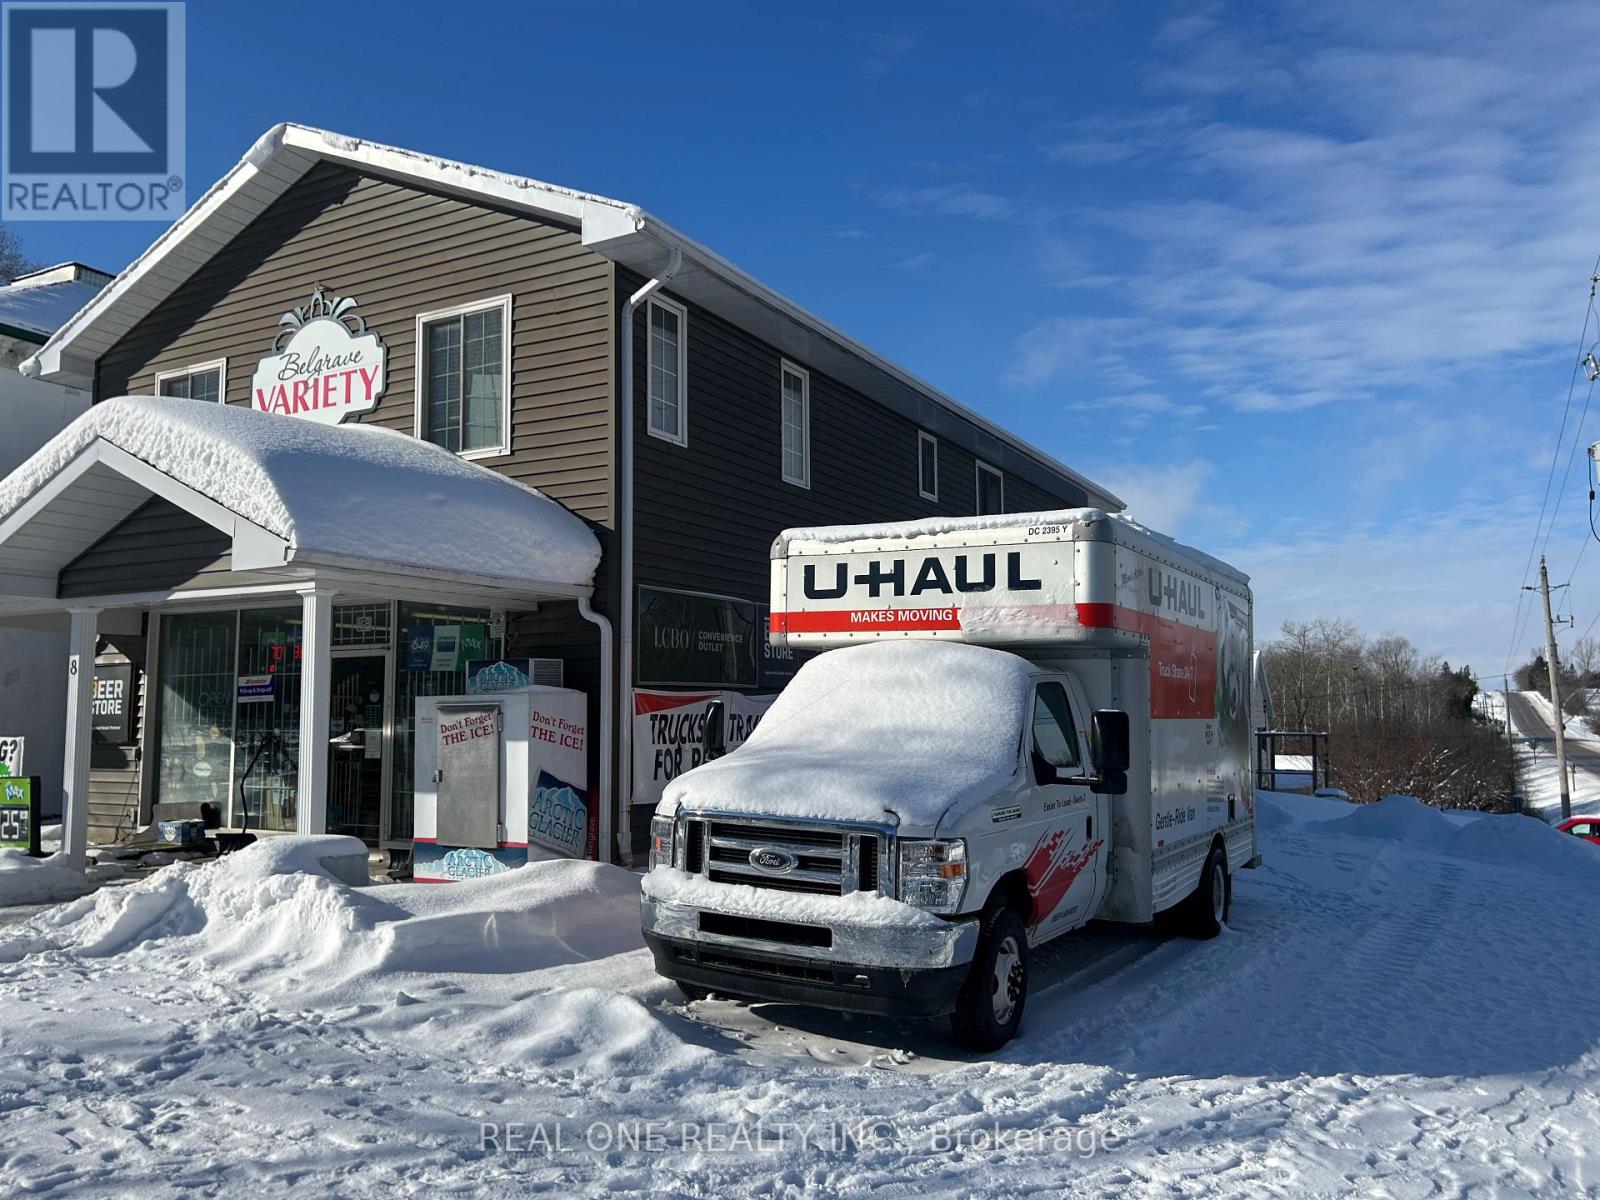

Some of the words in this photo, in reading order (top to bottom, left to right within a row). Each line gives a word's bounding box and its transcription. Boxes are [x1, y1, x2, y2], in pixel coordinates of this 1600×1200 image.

[278, 345, 363, 389] Belgrave
[256, 364, 380, 415] VARIETY
[1028, 527, 1041, 536] DC
[1042, 526, 1060, 535] 2395
[1062, 525, 1068, 534] Y
[851, 610, 895, 623] MAKES
[897, 609, 953, 622] MOVING
[654, 626, 690, 650] LCBO
[698, 630, 744, 643] CONVENIENCE
[698, 642, 724, 653] OUTLET
[70, 659, 77, 675] 8
[440, 719, 463, 734] Don't
[464, 713, 492, 728] Forget
[442, 730, 468, 746] THE
[470, 723, 495, 740] ICE!
[532, 711, 556, 727] Don't
[558, 718, 584, 736] Forget
[650, 713, 706, 745] TRUCKS
[531, 725, 556, 744] THE
[559, 733, 583, 751] ICE!
[653, 747, 682, 781] FOR
[533, 789, 586, 831] ARCTIC
[529, 811, 581, 848] GLACIER
[447, 853, 494, 868] ARCTIC
[760, 853, 780, 866] Ford
